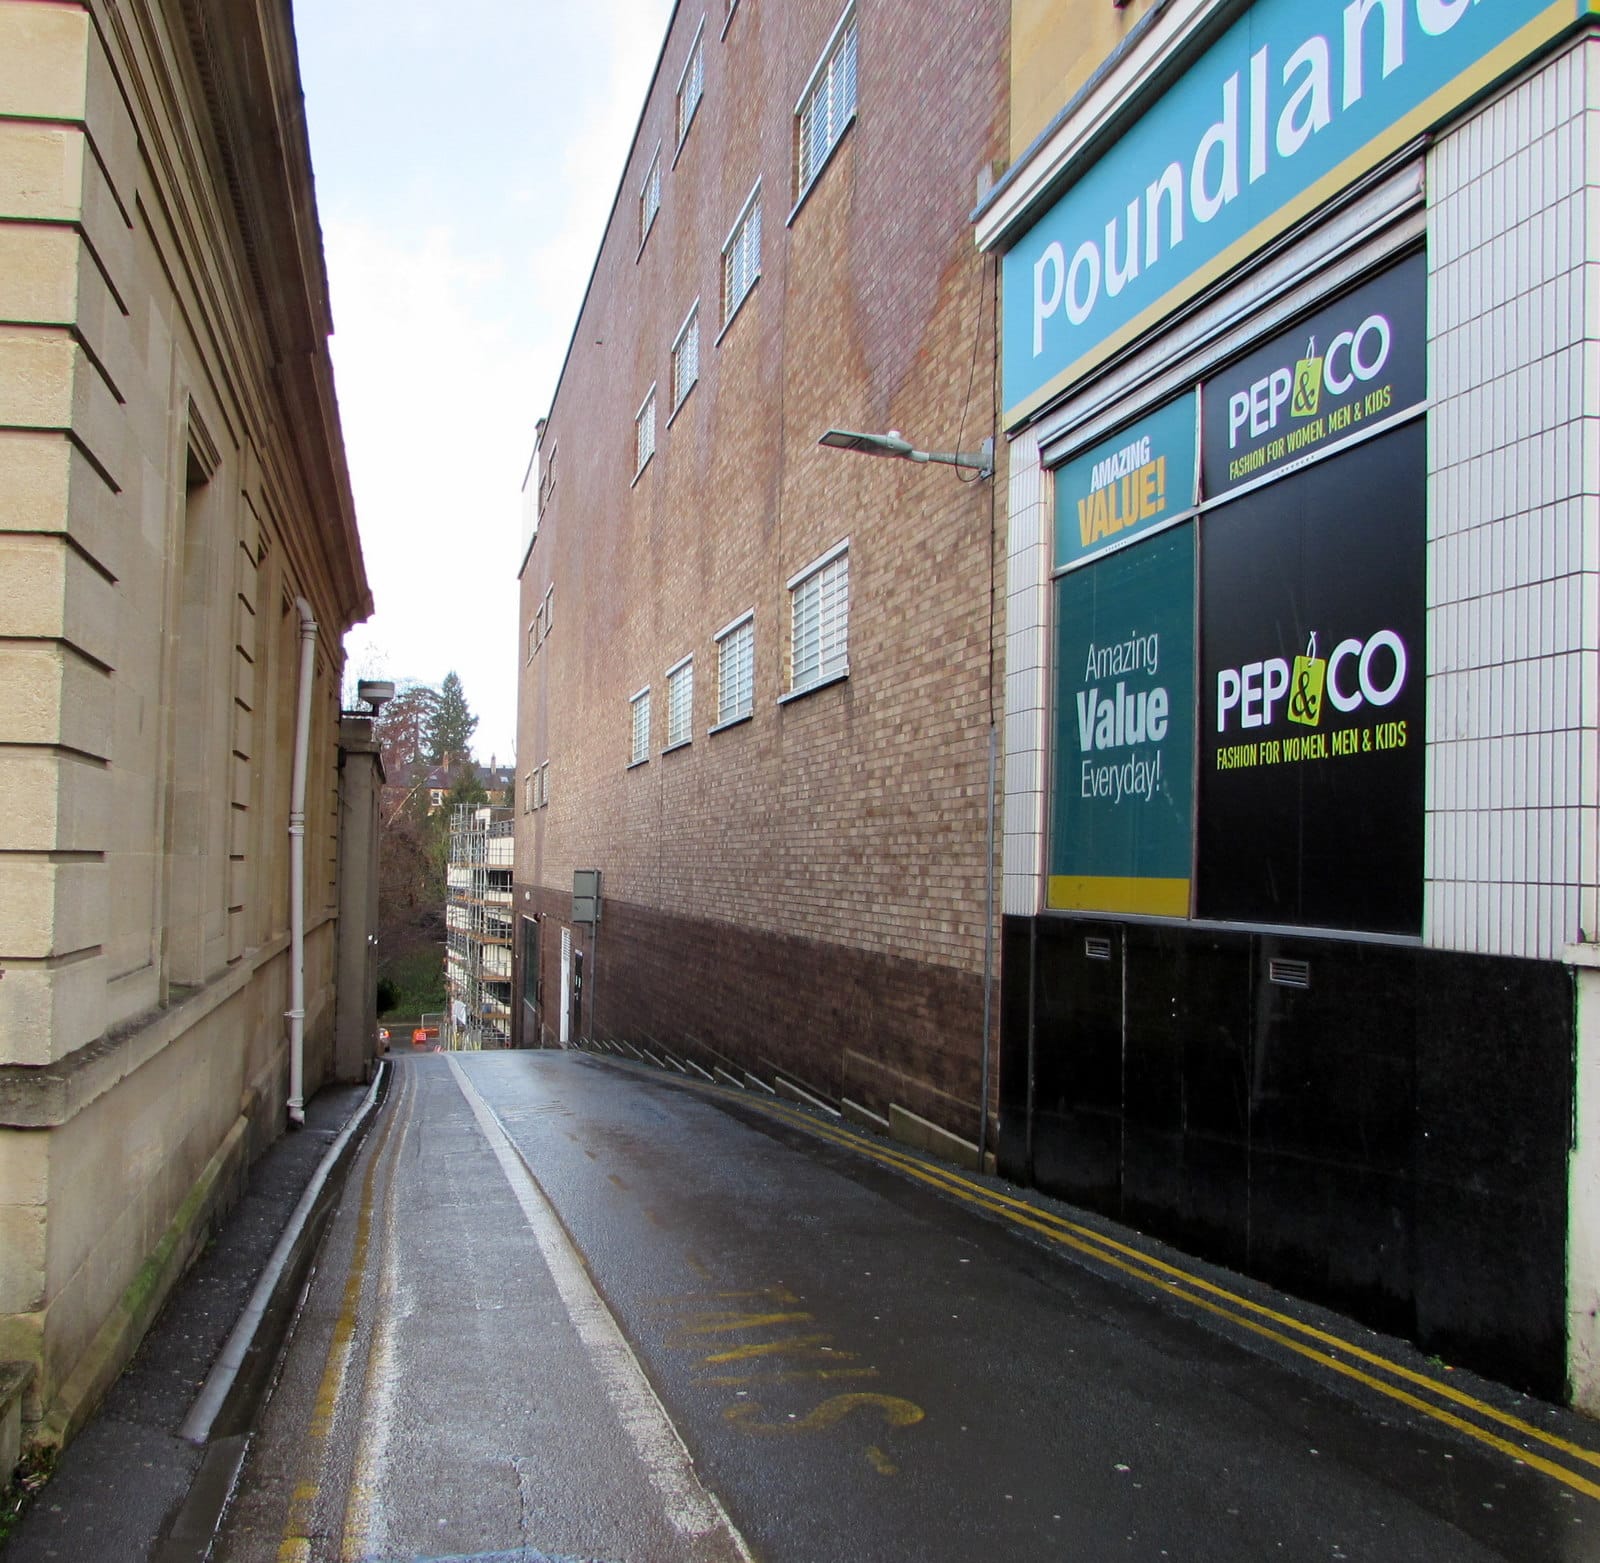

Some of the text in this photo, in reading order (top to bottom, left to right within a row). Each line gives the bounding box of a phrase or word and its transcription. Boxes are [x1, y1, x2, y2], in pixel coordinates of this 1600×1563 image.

[1032, 0, 1479, 359] Poundlan
[1090, 435, 1150, 493] AMAZING
[1229, 446, 1265, 480] FASHION
[1266, 438, 1285, 461] FOR
[1328, 404, 1352, 434] MEN
[1354, 400, 1362, 419] &
[1364, 385, 1392, 414] KIDS
[1077, 455, 1166, 547] VALUE!
[1085, 630, 1158, 682] Amazing
[1076, 682, 1169, 751] Value
[1216, 744, 1257, 770] FASHION
[1259, 741, 1280, 763] FOR
[1331, 728, 1359, 756] MEN
[1361, 729, 1371, 750] &
[1375, 721, 1406, 748] KIDS
[1081, 750, 1161, 804] Everyday!
